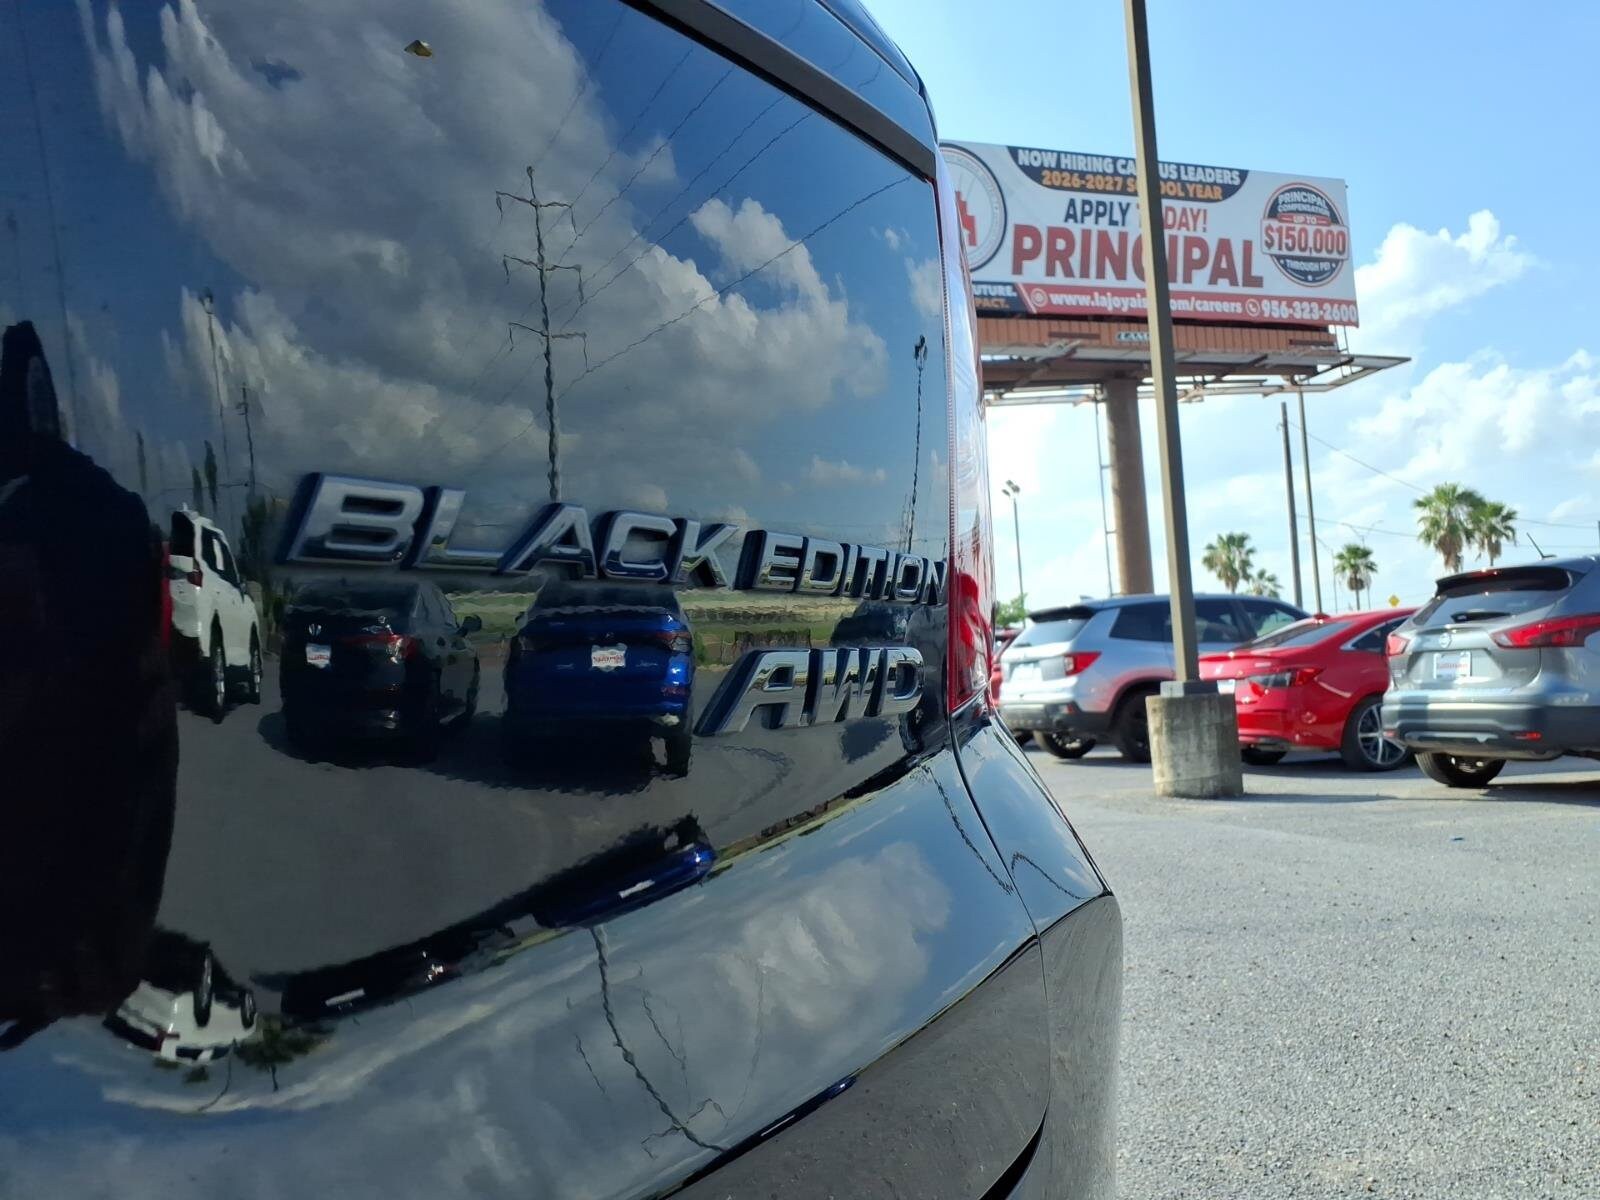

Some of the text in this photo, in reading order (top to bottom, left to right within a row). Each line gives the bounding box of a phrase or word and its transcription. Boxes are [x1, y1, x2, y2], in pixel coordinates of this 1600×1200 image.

[1017, 149, 1240, 186] NOW HIRING CAUS LEADERS
[1041, 169, 1123, 192] 2026-2027
[1186, 182, 1223, 200] YEAR
[1278, 191, 1329, 210] PRINCIPAL
[1064, 198, 1208, 233] APPLY DAY!
[1306, 216, 1317, 225] TO
[1264, 223, 1347, 257] $150,000
[972, 283, 1017, 297] UTURE.
[1261, 299, 1357, 322] 956-323-2600
[285, 472, 948, 605] BLACK EDITION
[694, 647, 925, 737] AWD
